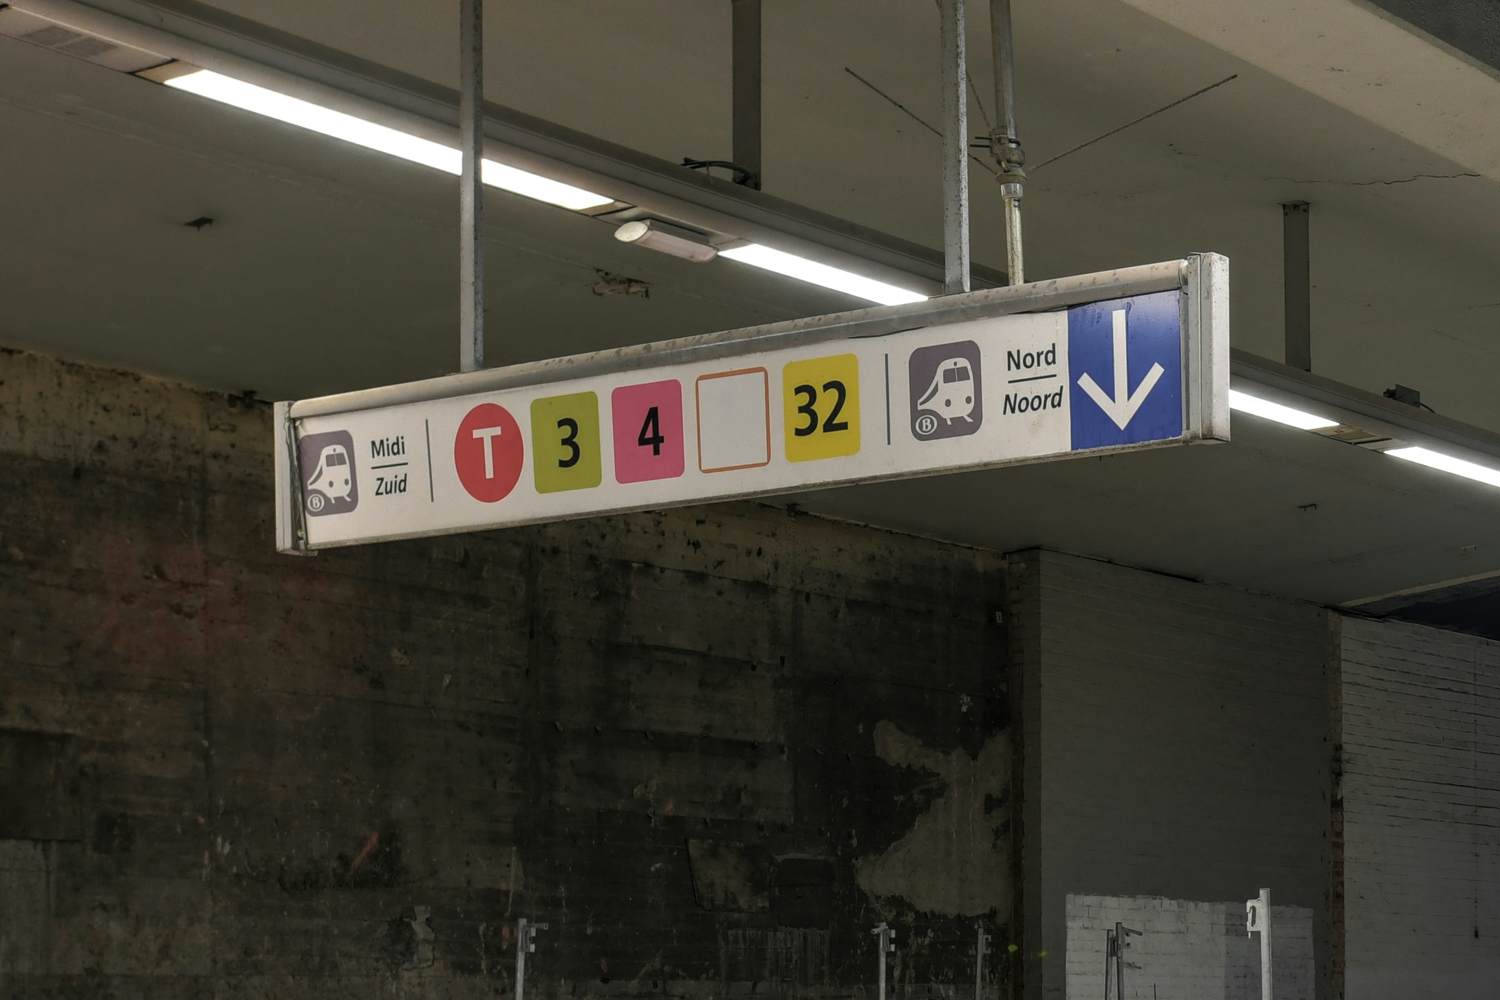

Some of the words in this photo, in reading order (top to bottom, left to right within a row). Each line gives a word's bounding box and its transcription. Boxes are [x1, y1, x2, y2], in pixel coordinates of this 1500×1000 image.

[1006, 343, 1057, 372] Nord
[1002, 386, 1064, 416] Noord
[472, 426, 502, 480] T
[557, 417, 581, 468] 3
[637, 406, 665, 456] 4
[793, 380, 849, 437] 32
[370, 435, 405, 459] Midi
[374, 475, 408, 497] Zuid
